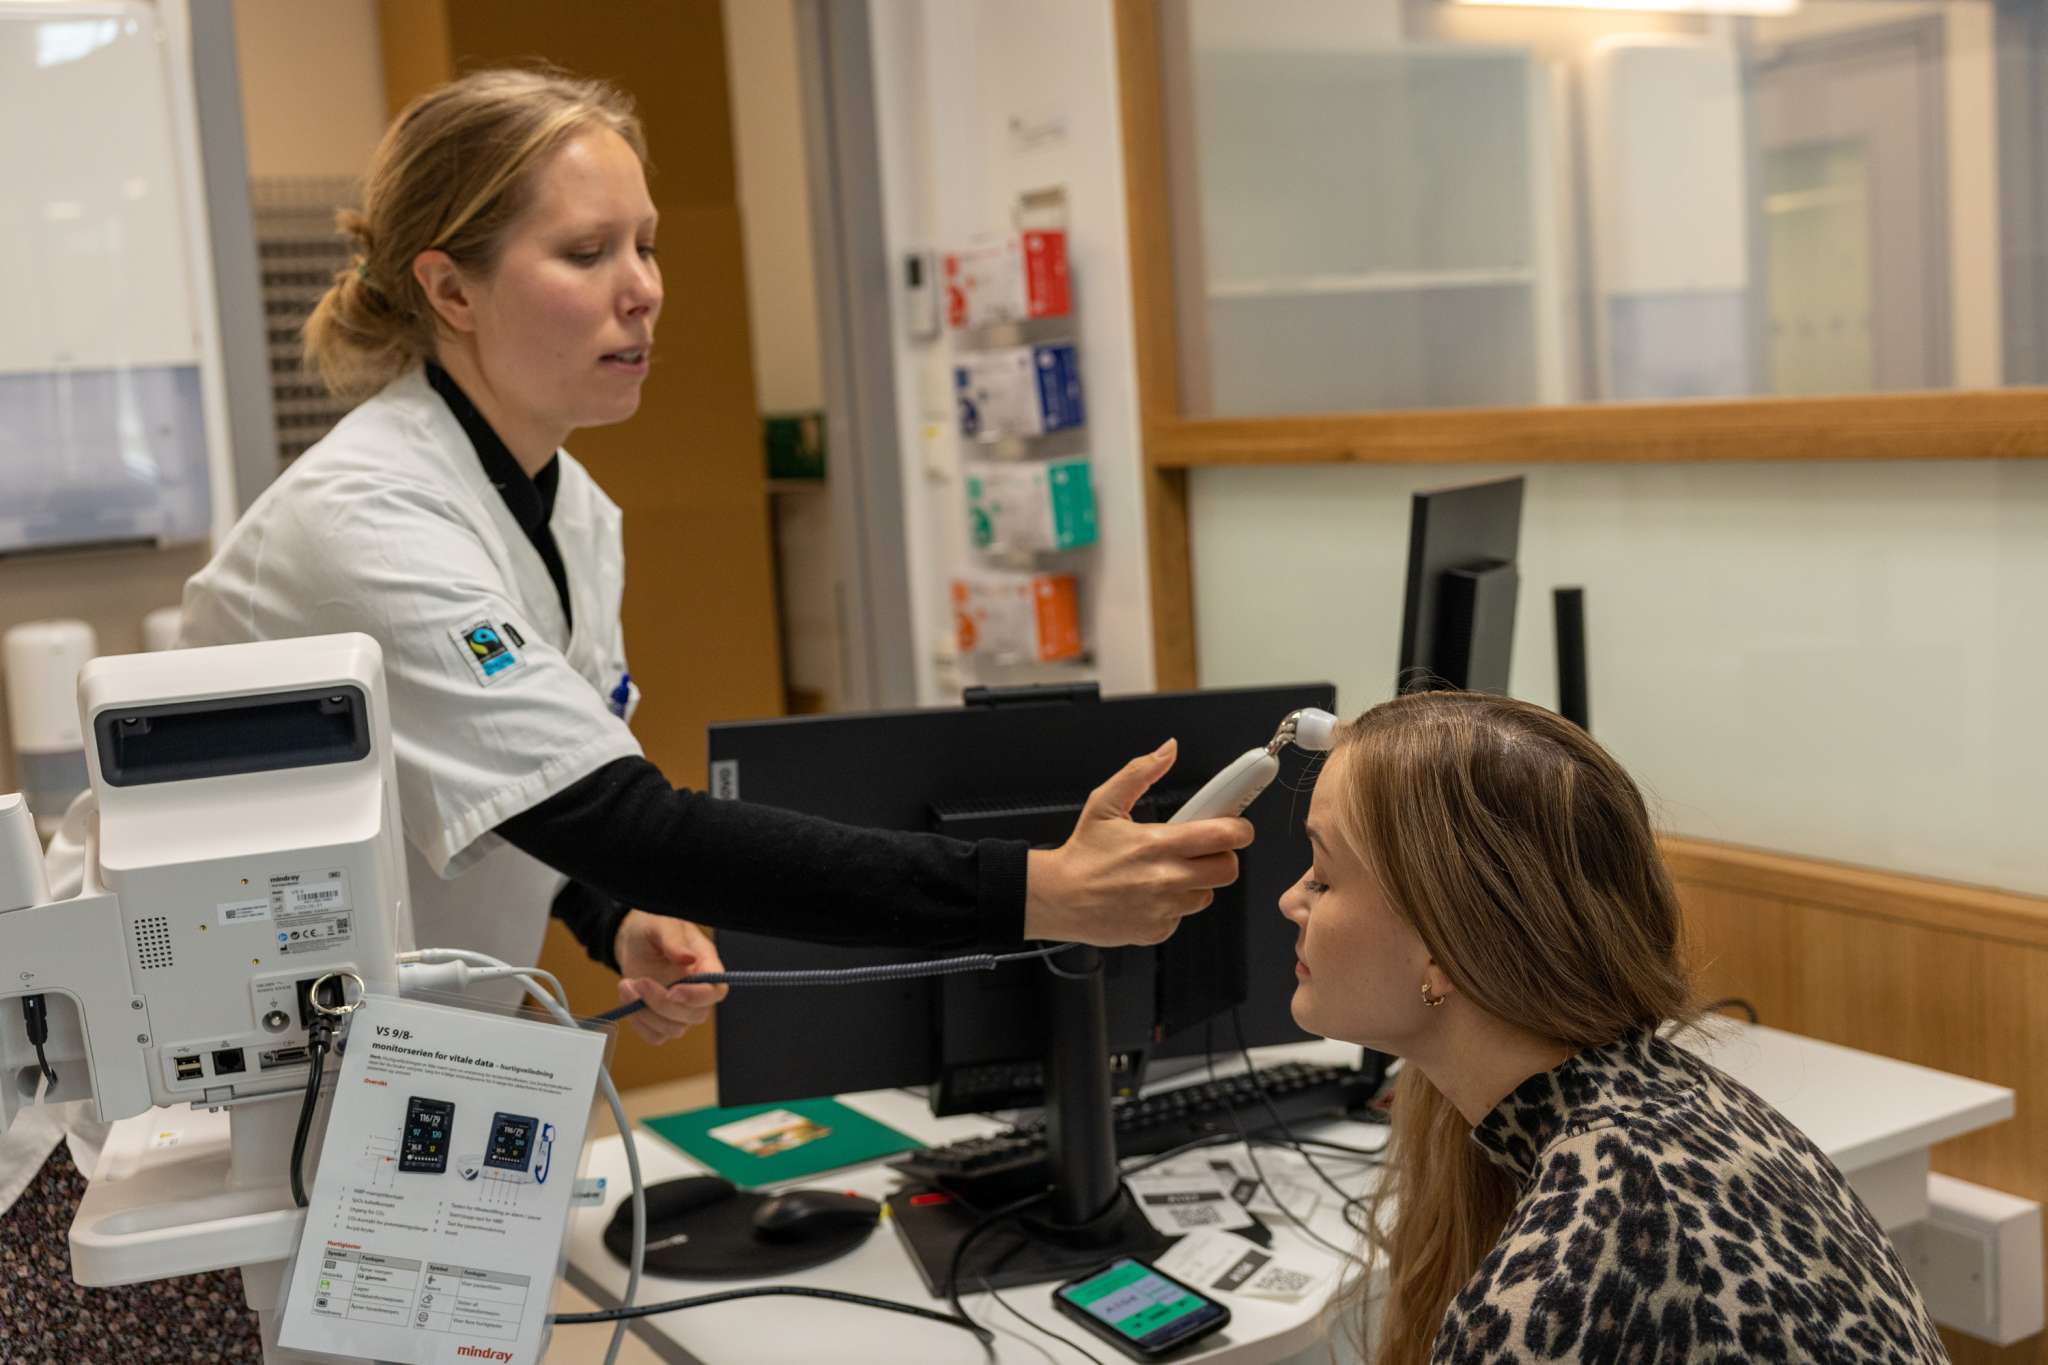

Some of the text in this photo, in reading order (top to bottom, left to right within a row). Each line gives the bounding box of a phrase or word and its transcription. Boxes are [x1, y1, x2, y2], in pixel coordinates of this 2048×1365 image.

[376, 1026, 390, 1037] VS
[372, 1041, 433, 1058] monitorserien
[434, 1051, 449, 1061] for
[449, 1054, 474, 1065] vitale
[474, 1057, 494, 1068] data
[457, 1345, 513, 1364] mindray
